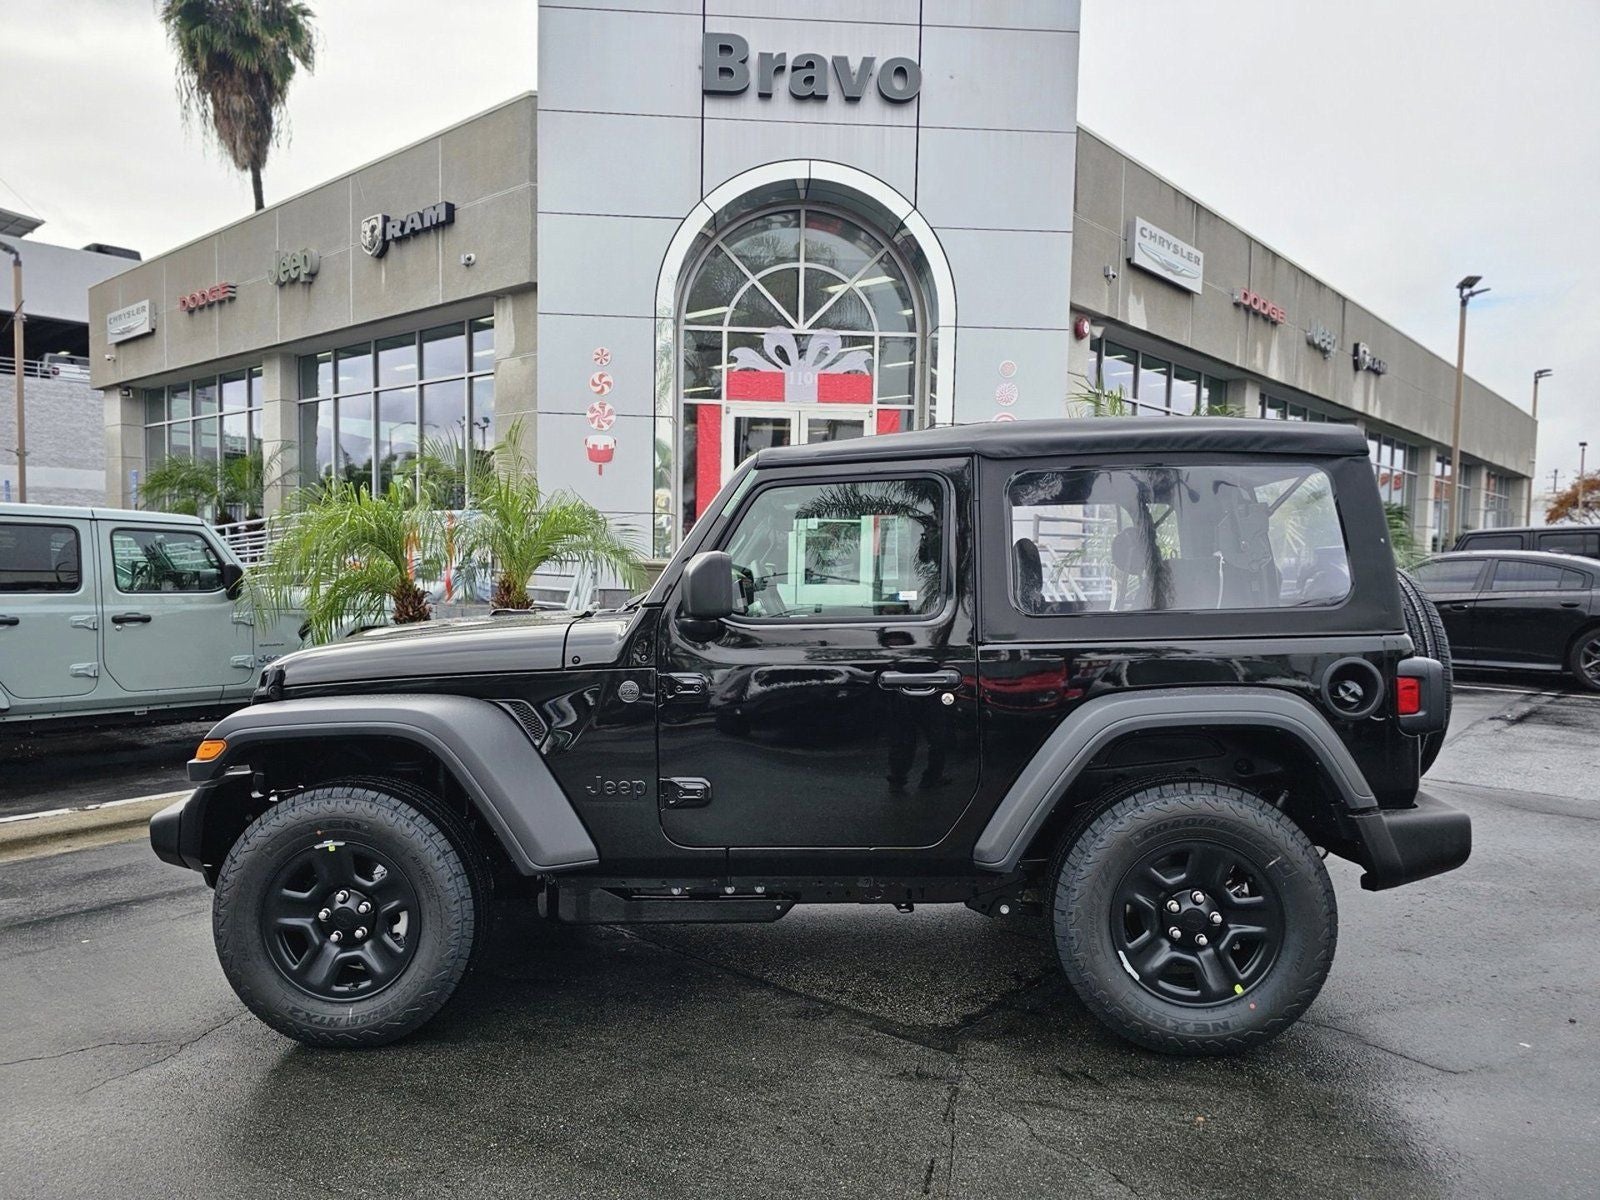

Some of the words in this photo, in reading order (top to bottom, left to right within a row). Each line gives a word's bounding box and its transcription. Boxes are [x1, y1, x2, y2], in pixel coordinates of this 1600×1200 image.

[702, 32, 922, 103] Bravo
[385, 201, 454, 241] RAM
[1139, 225, 1201, 267] CHRYSLER
[267, 248, 319, 286] Jeep
[108, 305, 147, 326] CHRYSLER
[178, 281, 236, 312] DODGE
[1238, 287, 1287, 325] DODGE
[586, 775, 647, 799] Jeep
